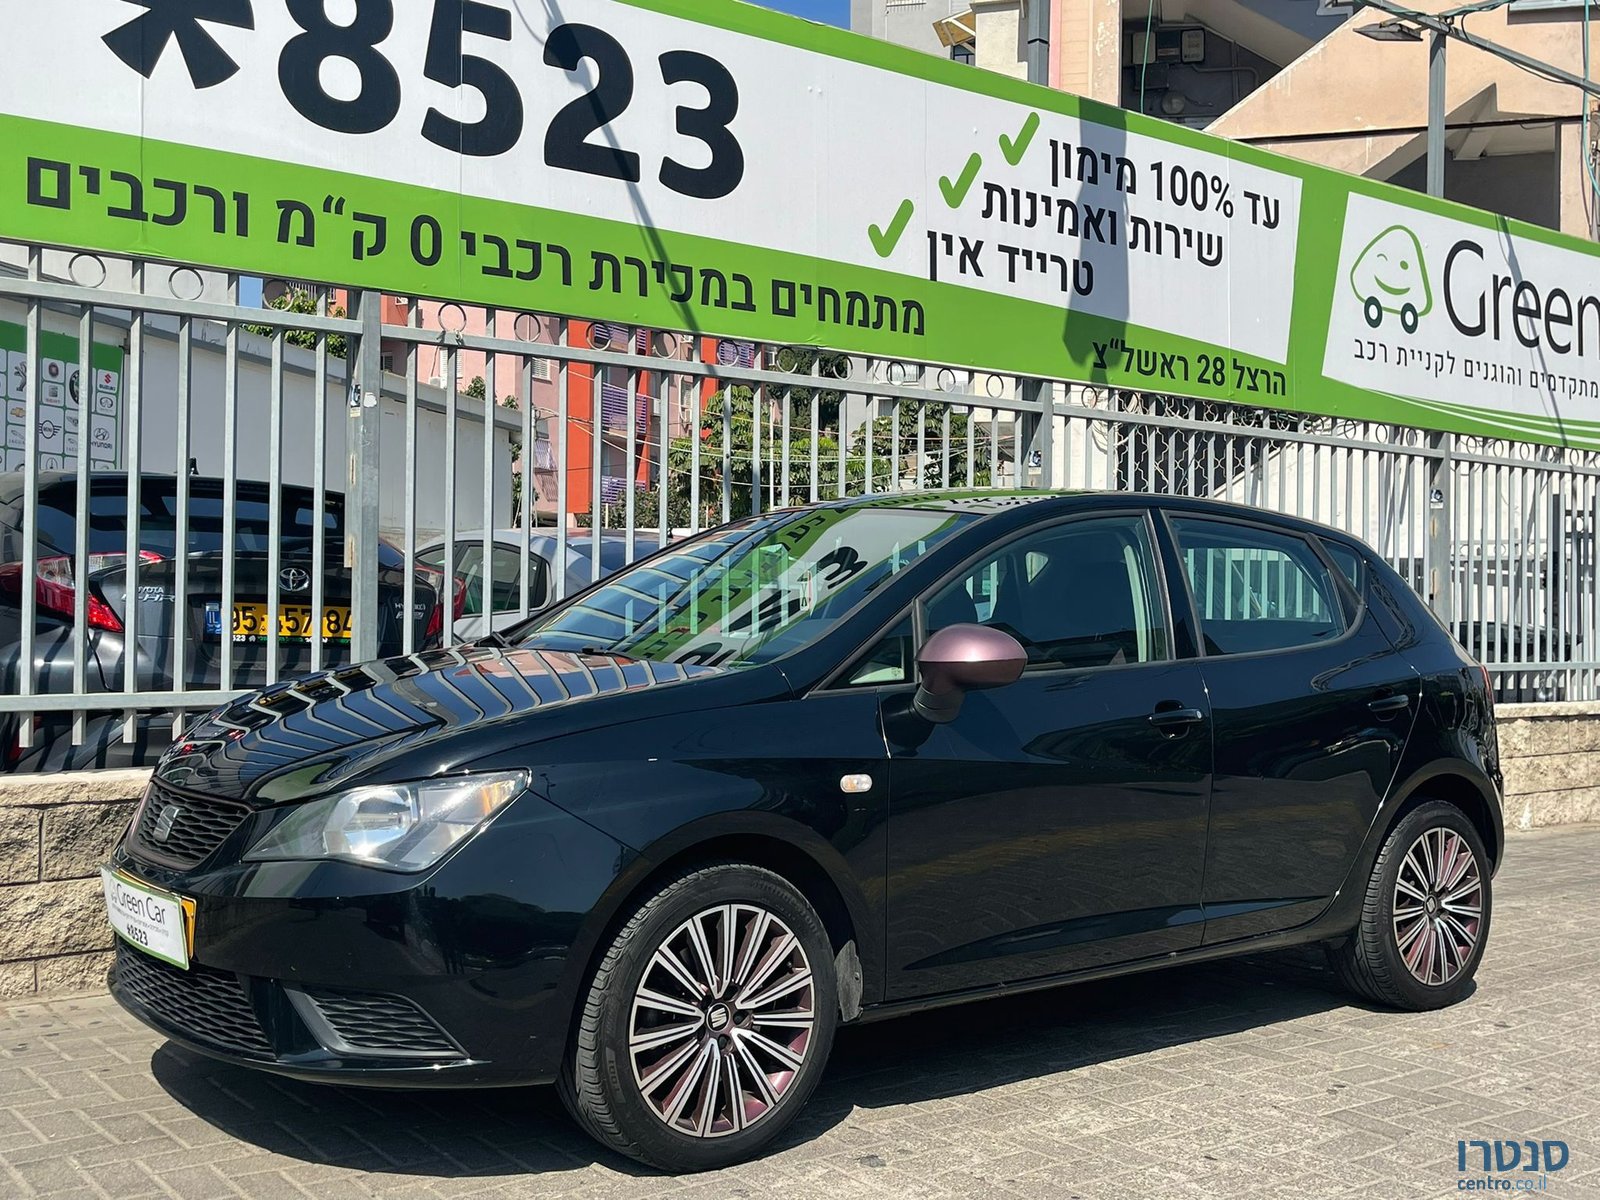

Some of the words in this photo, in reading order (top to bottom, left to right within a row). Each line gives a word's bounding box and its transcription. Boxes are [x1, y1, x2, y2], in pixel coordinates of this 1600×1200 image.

[1049, 138, 1137, 195] מימון
[1150, 161, 1234, 218] 100%
[27, 156, 249, 238] ורכבים
[981, 181, 1117, 246] ואמינות
[1243, 190, 1280, 230] עד
[276, 194, 387, 260] ק"מ
[410, 214, 442, 267] 0
[1128, 215, 1223, 267] שירות
[460, 230, 572, 287] רכבי
[588, 250, 757, 313] במכירת
[927, 230, 984, 282] אין
[997, 243, 1094, 296] טרייד
[771, 278, 925, 336] מתמחים
[1197, 353, 1226, 387] 28
[1233, 357, 1286, 396] הרצל
[1354, 338, 1388, 363] רכב
[1396, 346, 1456, 378] לקניית
[1464, 359, 1523, 387] והוגנים
[1530, 370, 1599, 400] מתקדמים
[117, 883, 145, 917] Green
[146, 897, 165, 925] Car
